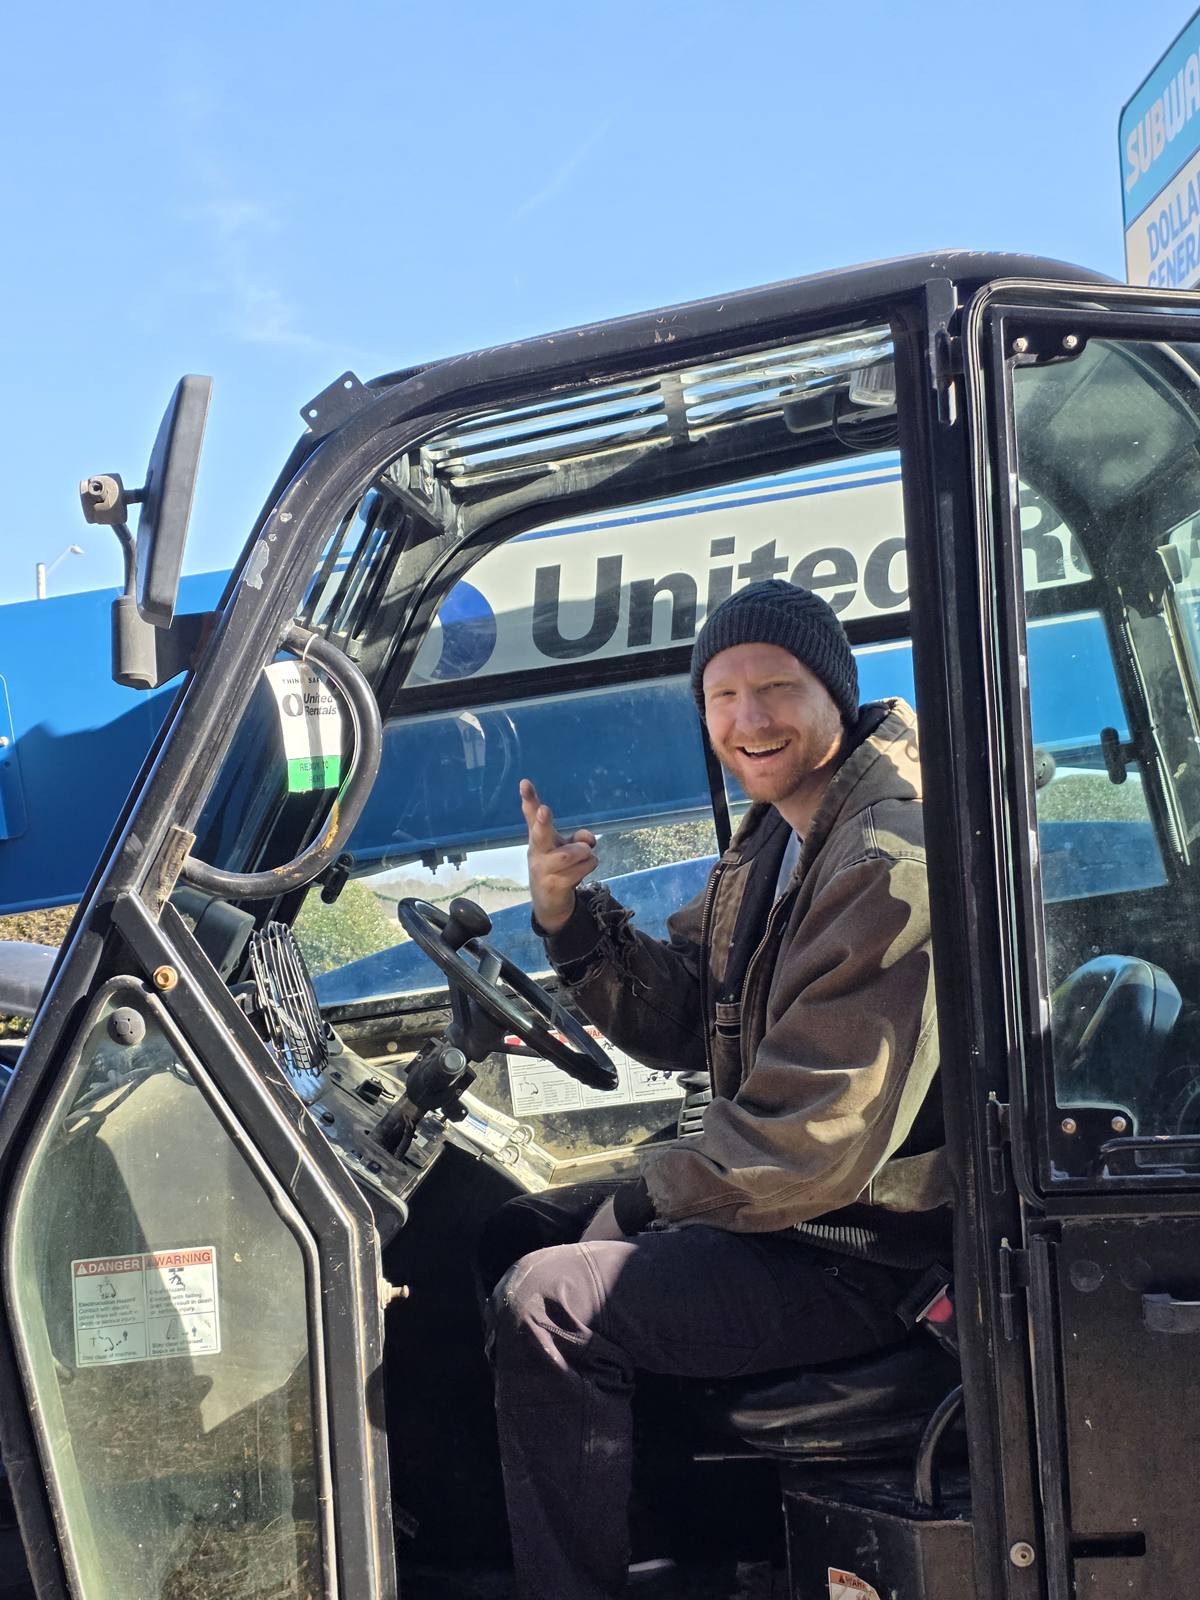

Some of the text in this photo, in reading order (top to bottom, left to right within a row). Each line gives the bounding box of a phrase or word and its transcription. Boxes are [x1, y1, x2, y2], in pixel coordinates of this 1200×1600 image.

[1126, 45, 1200, 192] SUBWA
[1147, 170, 1200, 262] DOLLA
[303, 692, 333, 704] United
[304, 705, 337, 716] Rentals
[88, 1259, 140, 1273] DANGER
[155, 1252, 211, 1266] WARNING
